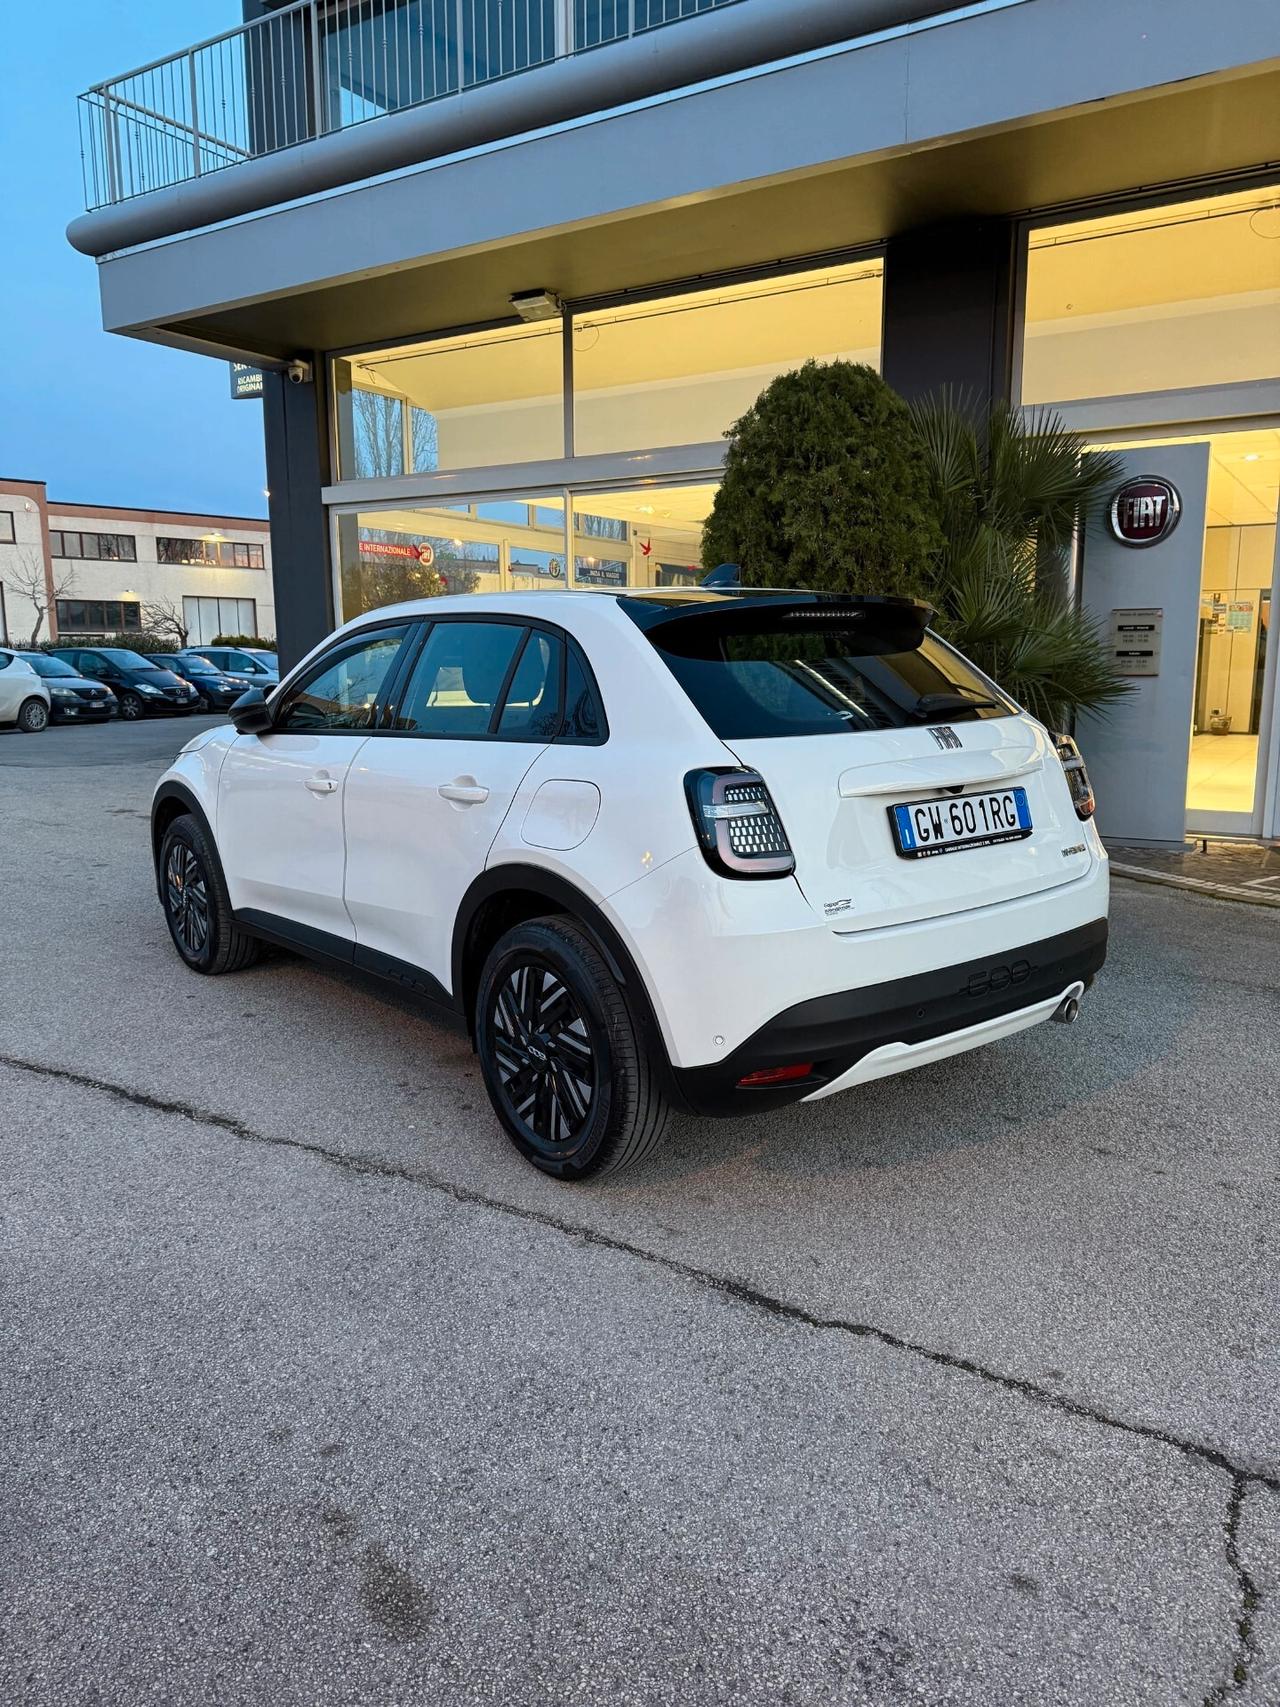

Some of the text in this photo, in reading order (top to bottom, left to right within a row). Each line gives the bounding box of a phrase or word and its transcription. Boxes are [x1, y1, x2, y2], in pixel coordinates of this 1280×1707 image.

[1122, 495, 1166, 528] FIAT
[363, 543, 411, 556] INTERNAZIONALE
[915, 805, 944, 842] GW
[949, 795, 1016, 835] 601RG
